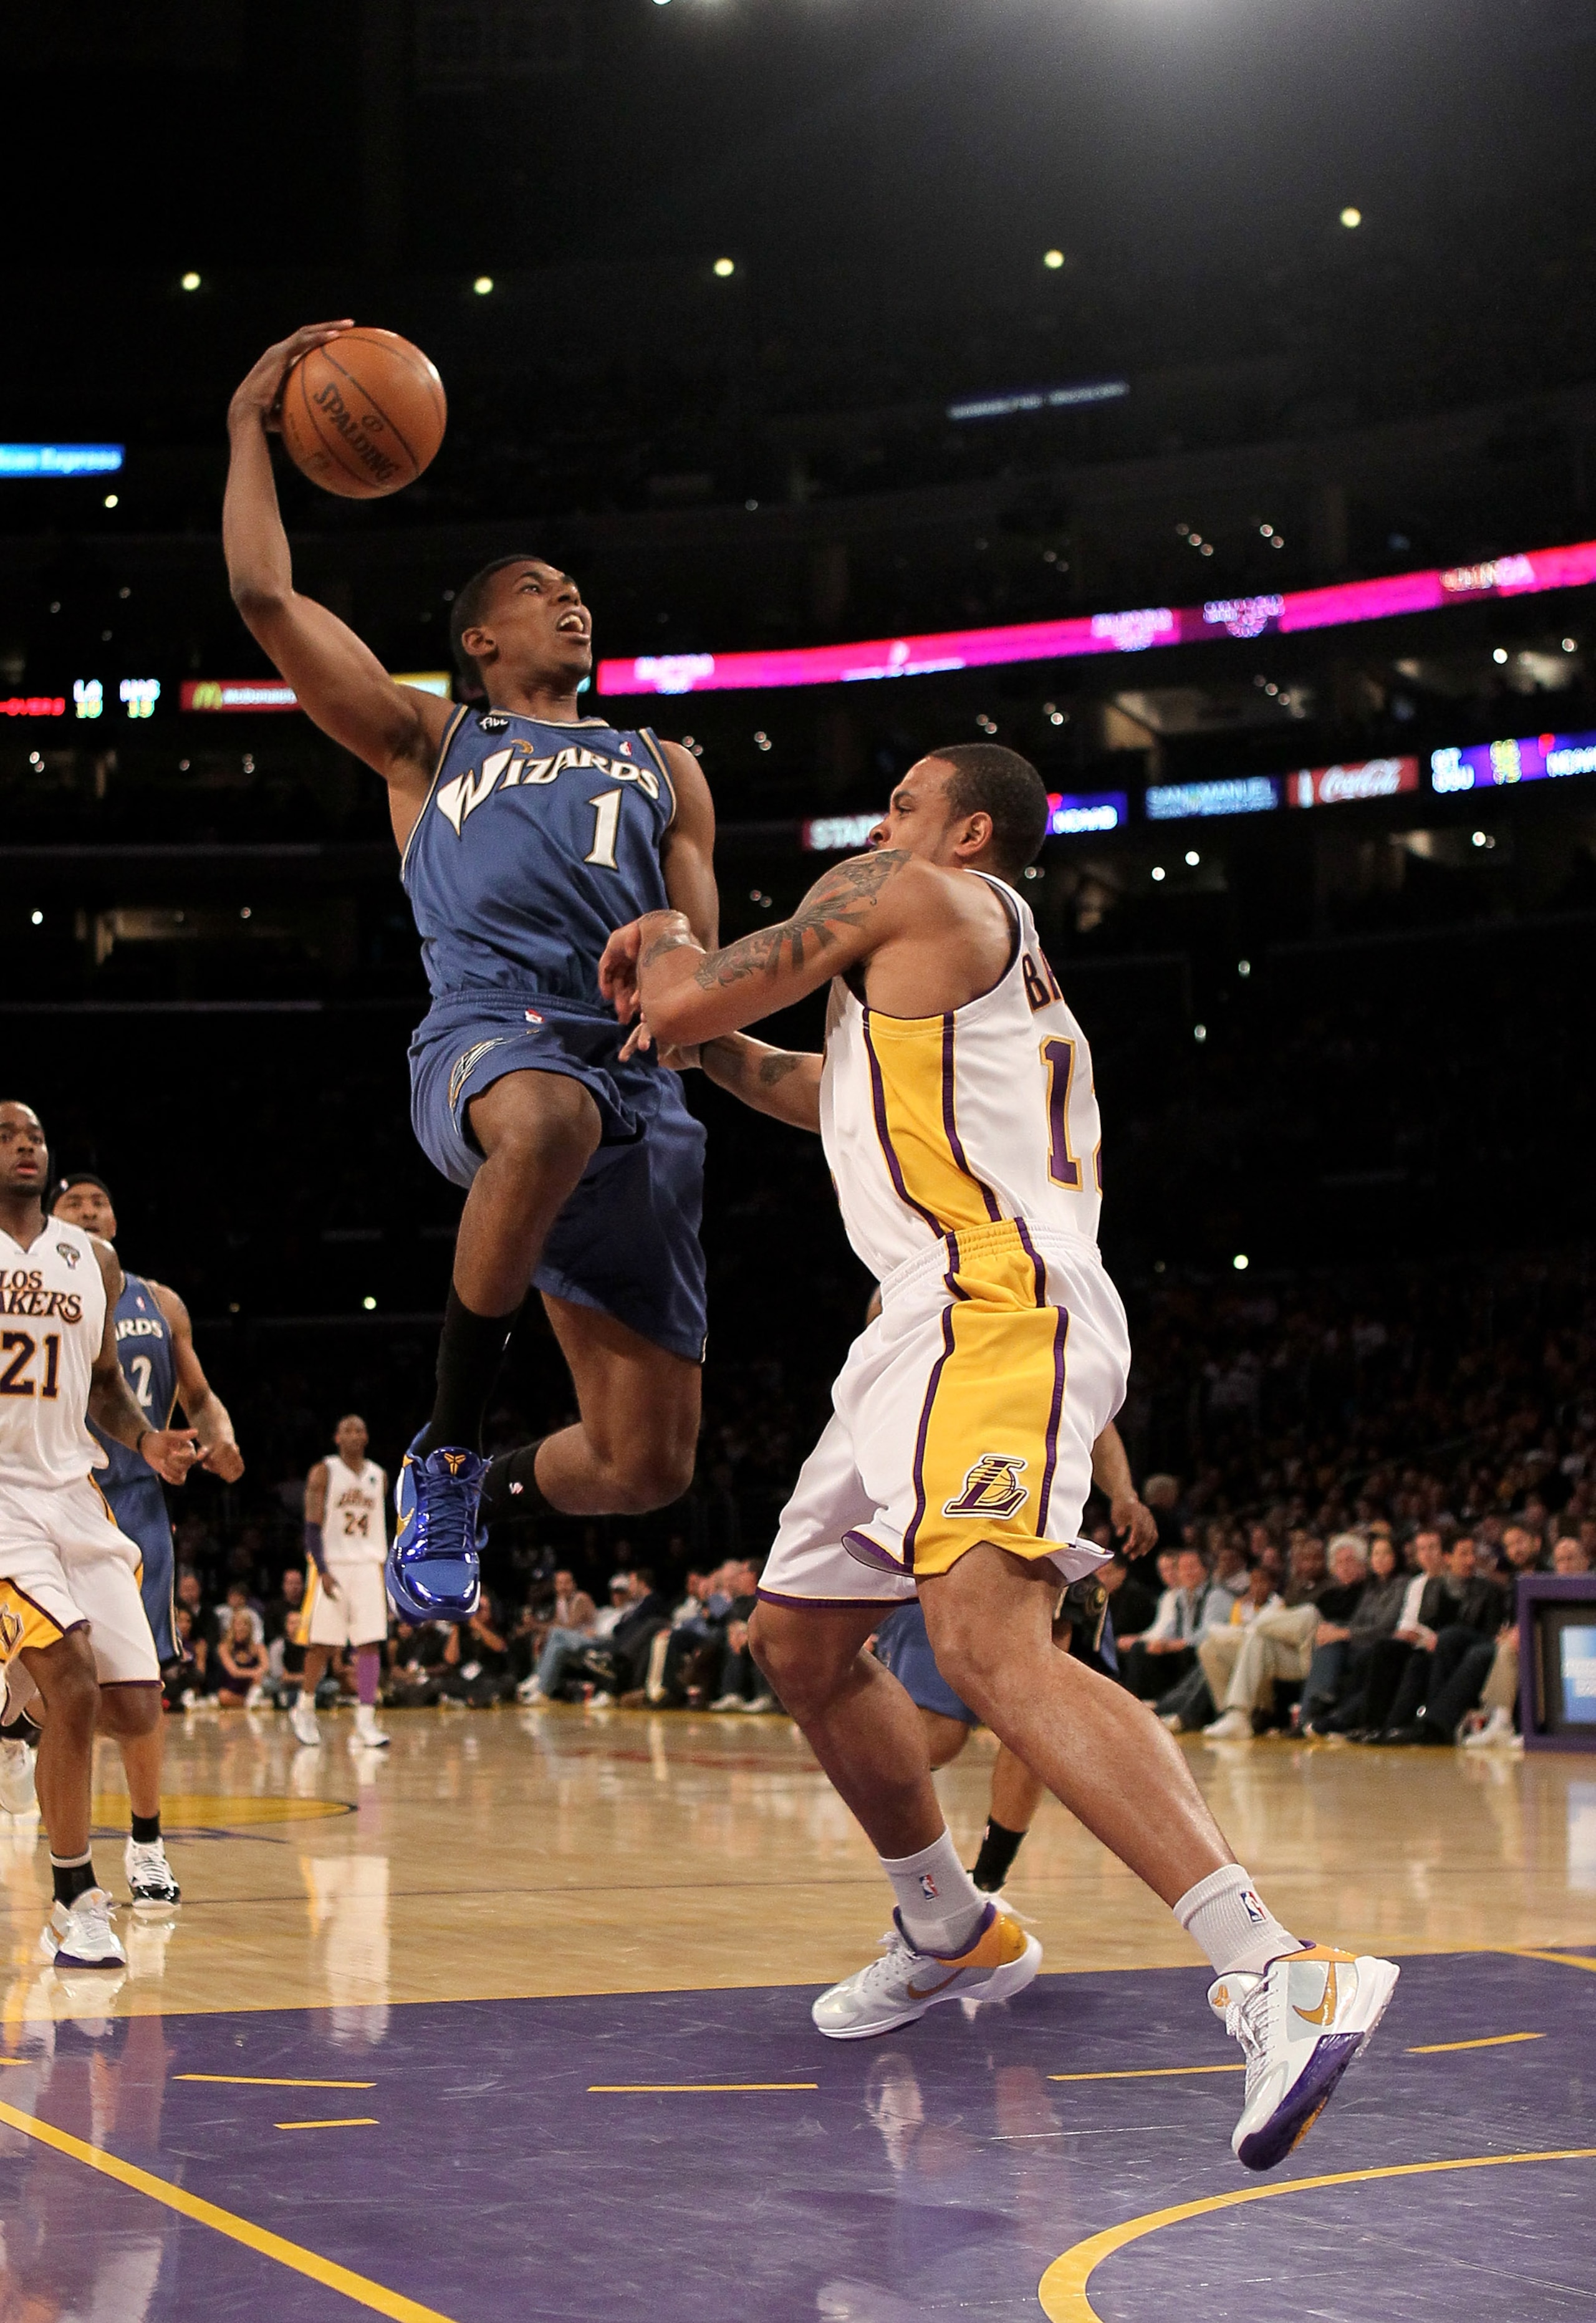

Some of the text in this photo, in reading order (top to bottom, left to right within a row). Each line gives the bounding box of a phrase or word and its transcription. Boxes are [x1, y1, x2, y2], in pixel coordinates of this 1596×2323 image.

[314, 382, 399, 483] SPALDING
[584, 788, 622, 870] 1
[1039, 1034, 1102, 1200] 1
[0, 1270, 43, 1291] LOS
[0, 1329, 61, 1400] 21
[345, 1511, 368, 1537] 24
